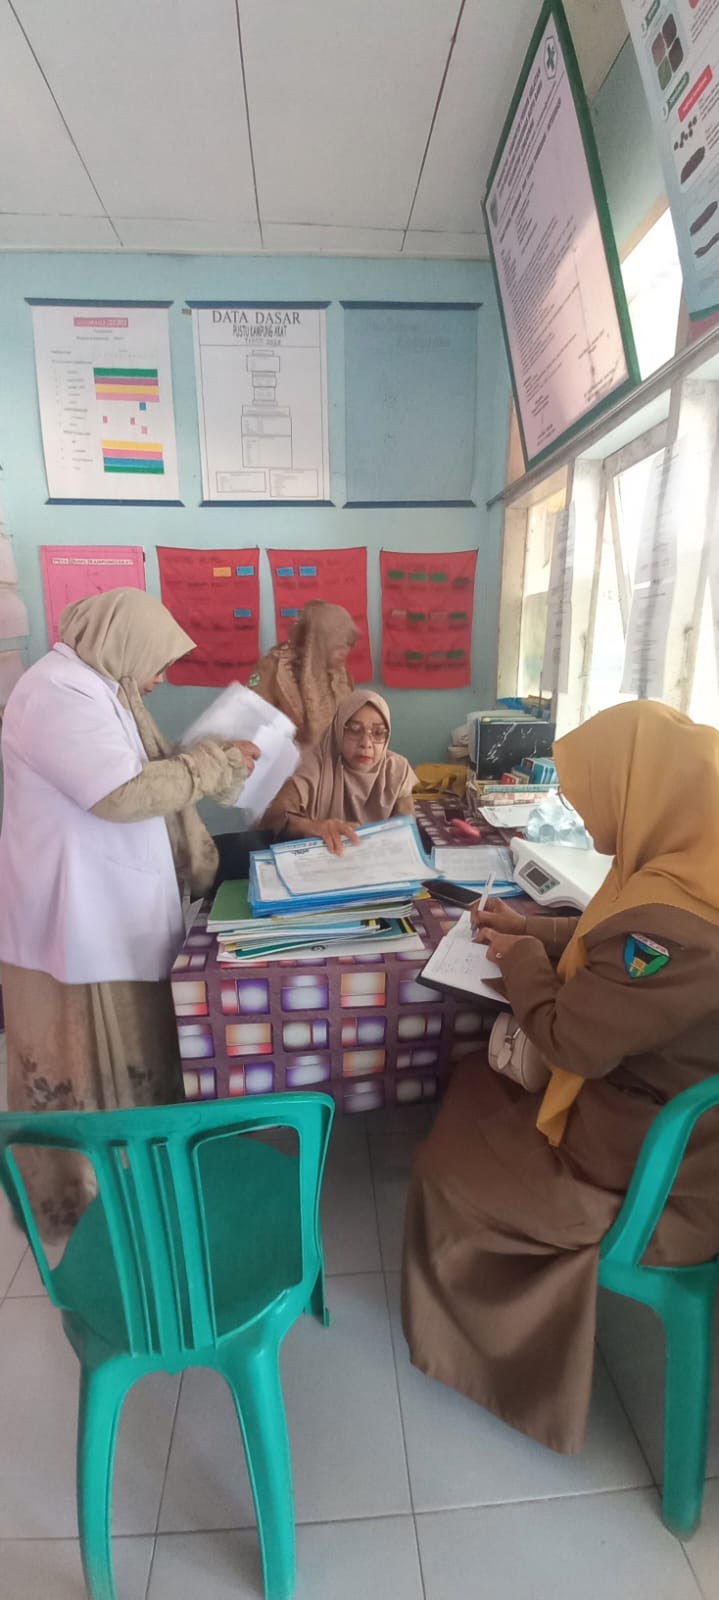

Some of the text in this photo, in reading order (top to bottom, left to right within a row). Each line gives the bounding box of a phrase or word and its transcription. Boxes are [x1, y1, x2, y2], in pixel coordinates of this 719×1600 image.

[212, 310, 301, 324] DATA DASAR
[233, 325, 250, 337] PUSTU
